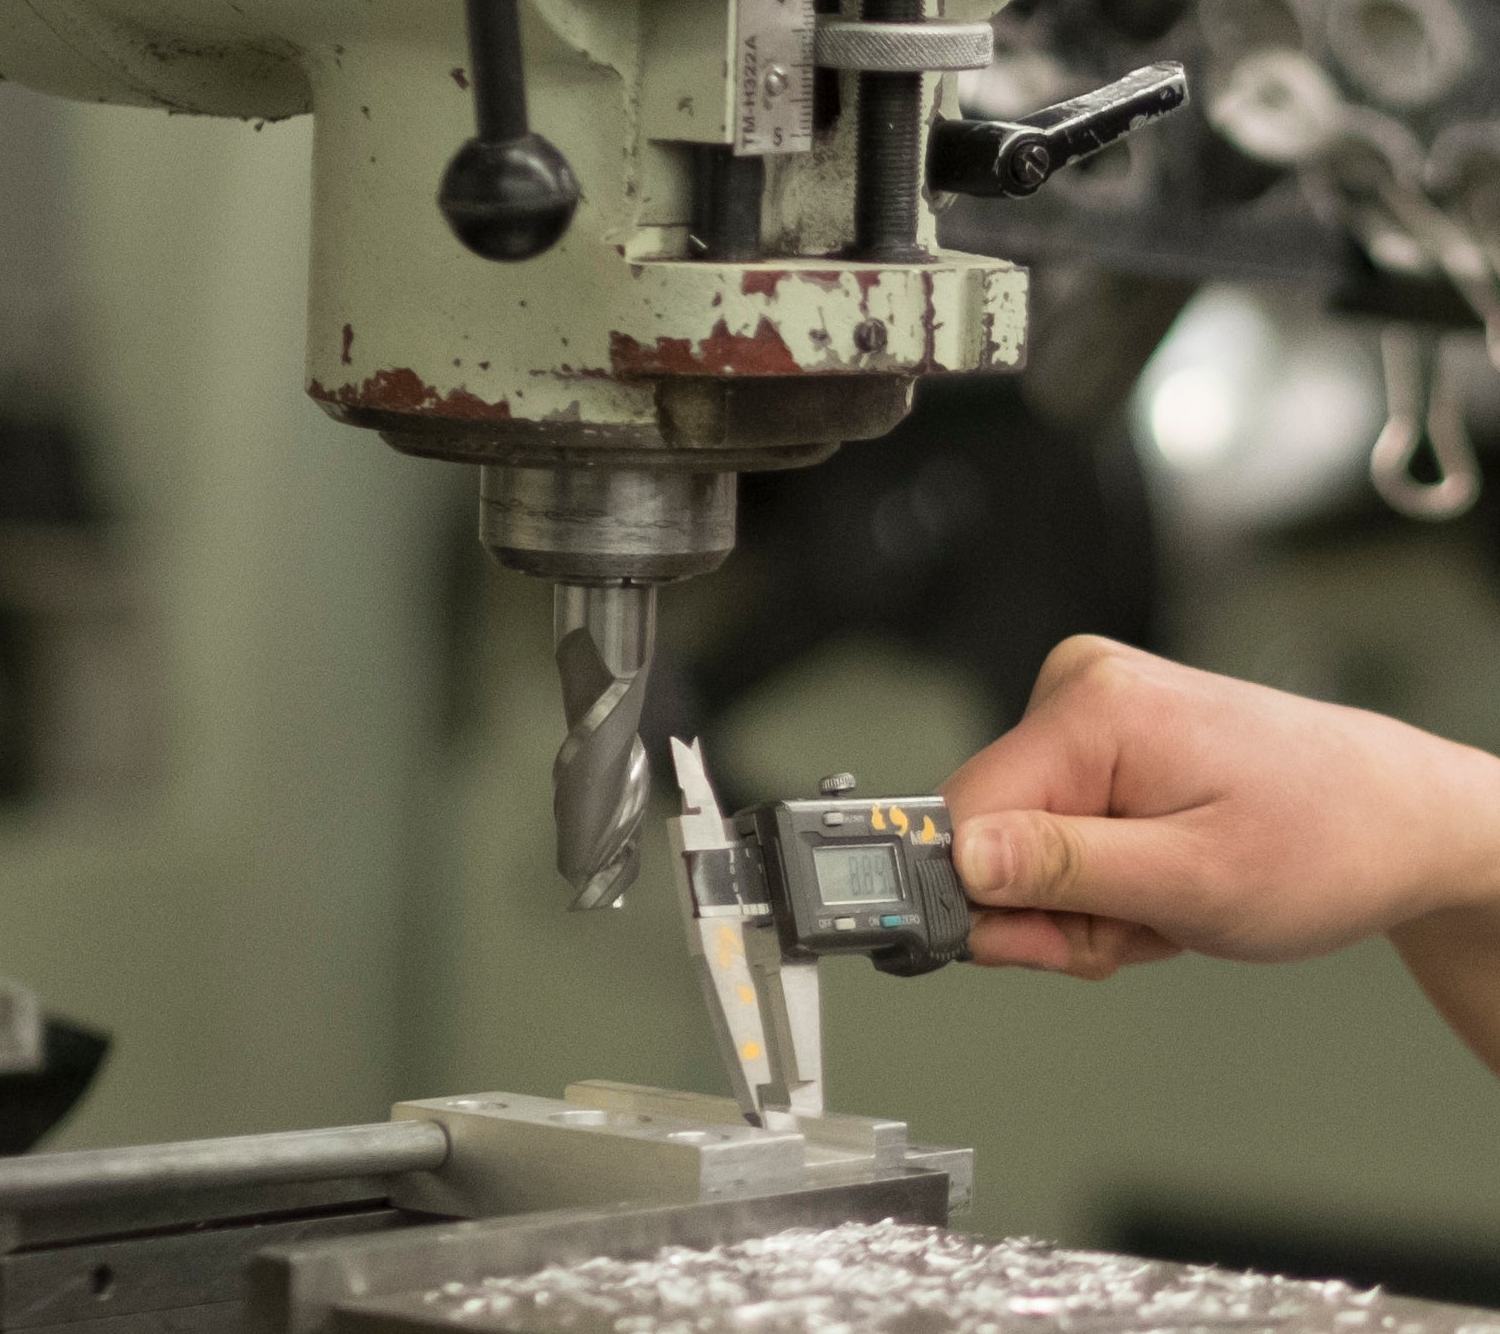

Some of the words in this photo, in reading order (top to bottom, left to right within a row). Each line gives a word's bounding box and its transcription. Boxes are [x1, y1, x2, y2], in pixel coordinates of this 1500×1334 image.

[742, 35, 757, 148] TM-H322A
[818, 918, 832, 929] OFF
[868, 915, 880, 927] ON
[900, 913, 921, 926] ZERO
